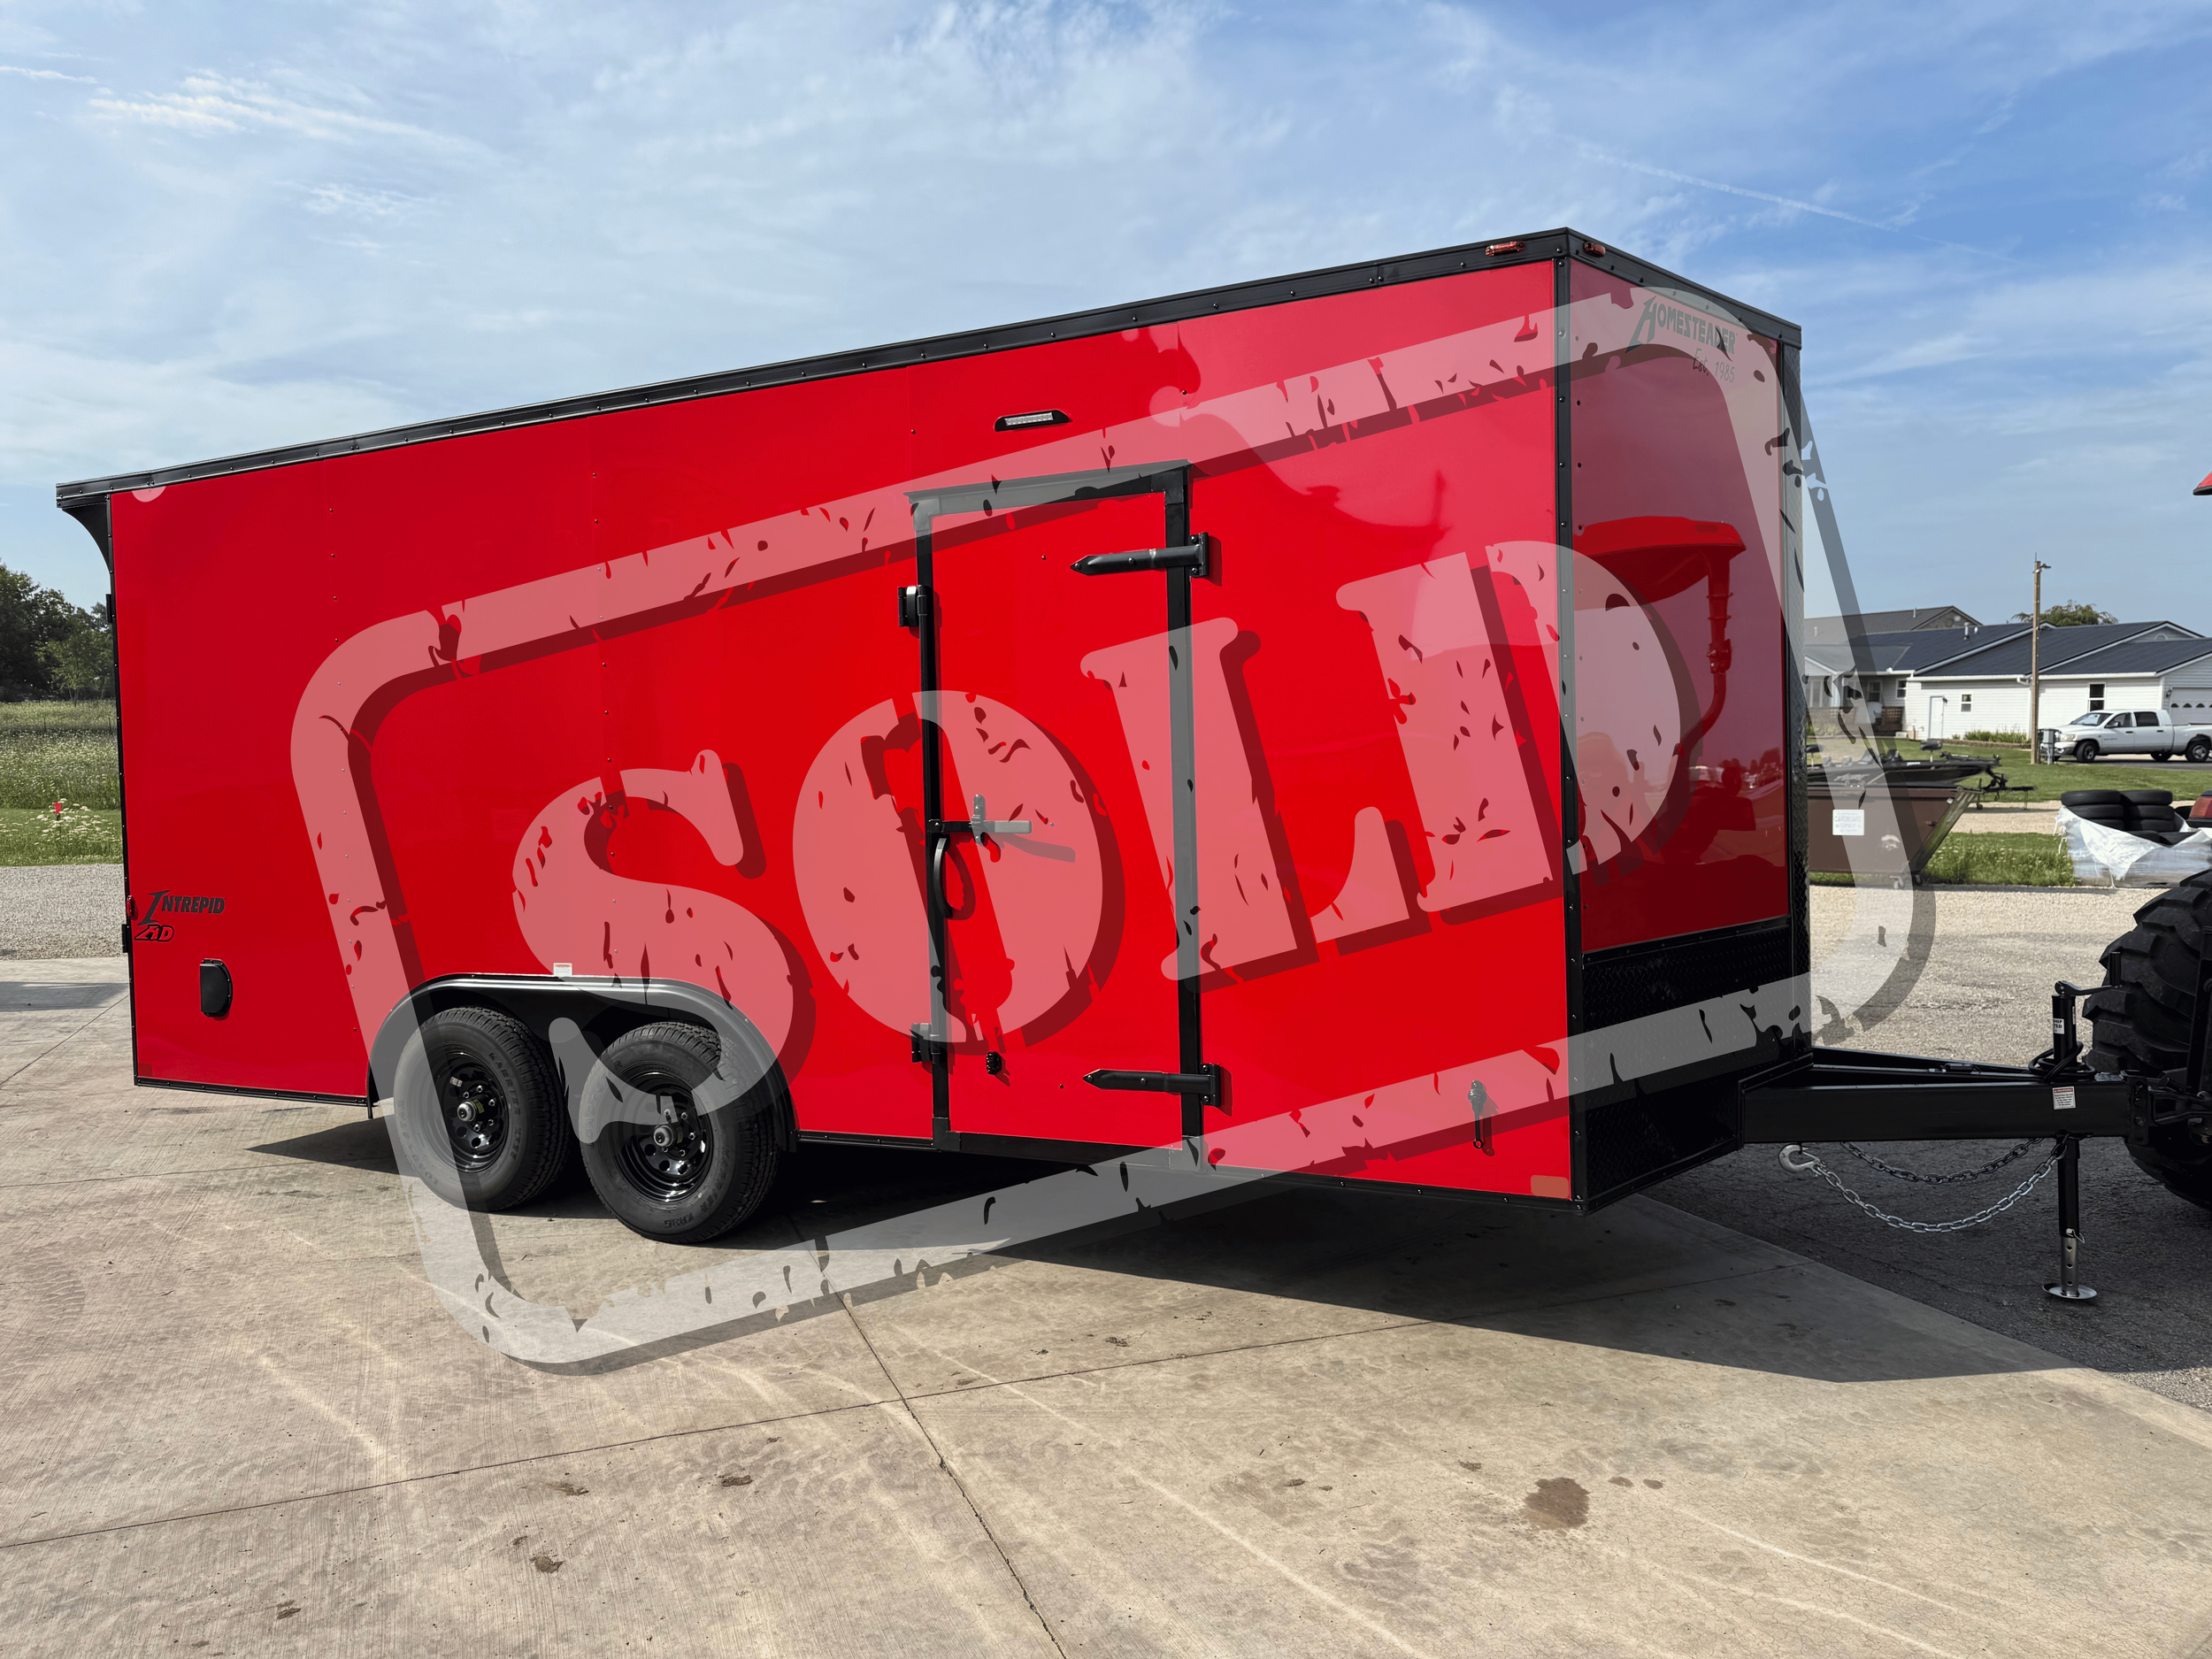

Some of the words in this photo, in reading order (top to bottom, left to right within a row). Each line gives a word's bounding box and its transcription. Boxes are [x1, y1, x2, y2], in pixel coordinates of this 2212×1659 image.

[1625, 296, 1736, 355] HOMESTEADER
[1693, 348, 1709, 377] Est.
[1715, 361, 1736, 383] 1985
[137, 889, 226, 926] INTREPID
